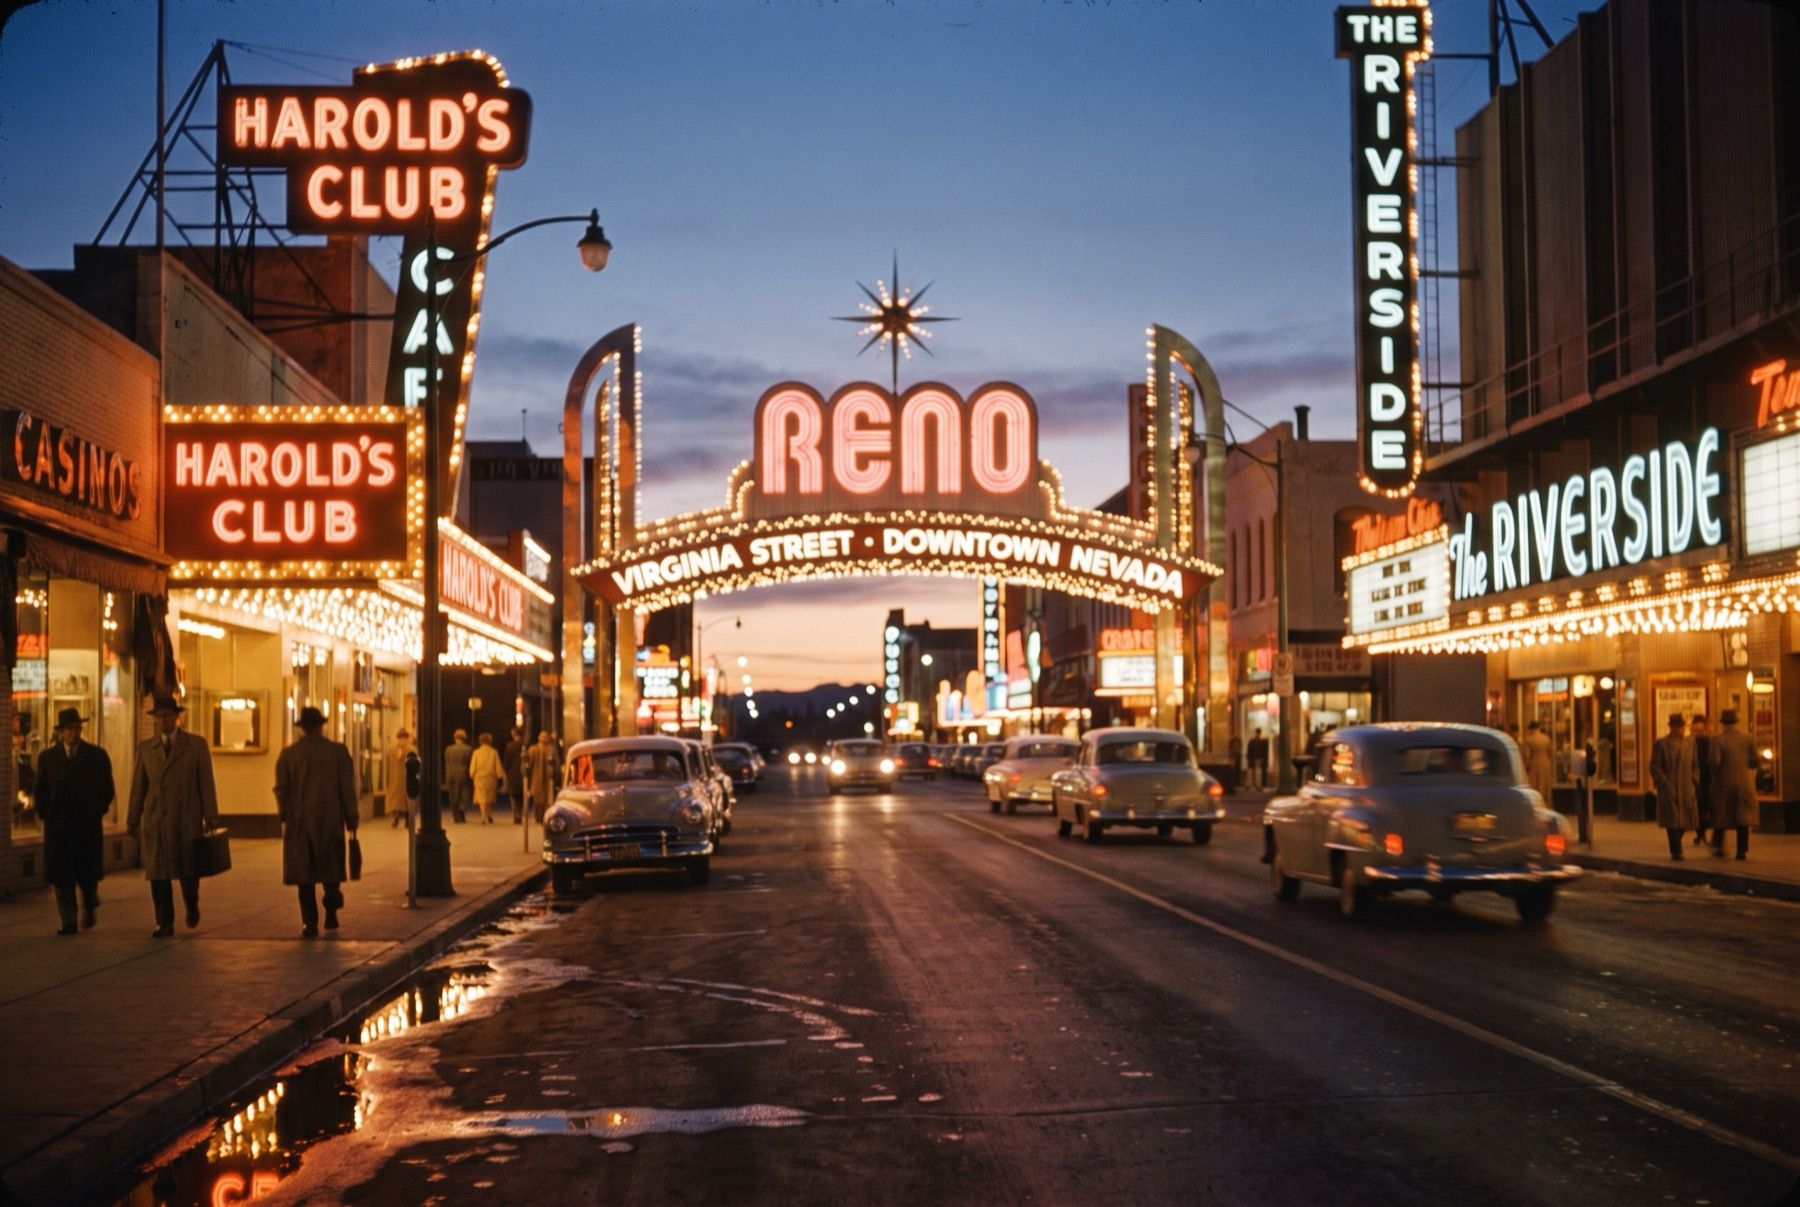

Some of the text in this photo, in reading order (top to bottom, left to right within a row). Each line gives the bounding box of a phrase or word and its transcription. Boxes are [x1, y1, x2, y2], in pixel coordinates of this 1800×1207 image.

[1347, 15, 1418, 43] THE
[234, 92, 512, 153] HAROLD'S
[307, 165, 467, 220] CLUB
[1364, 54, 1407, 469] RIVERSIDE
[14, 409, 143, 520] CASINOS
[175, 435, 396, 487] HAROLD'S
[762, 388, 1032, 495] RENO
[212, 500, 358, 543] CLUB
[1449, 511, 1488, 601] The
[1491, 426, 1722, 593] RIVERSIDE
[611, 528, 1183, 599] VIRGINIA STREET DOWNTOWN NEVADA
